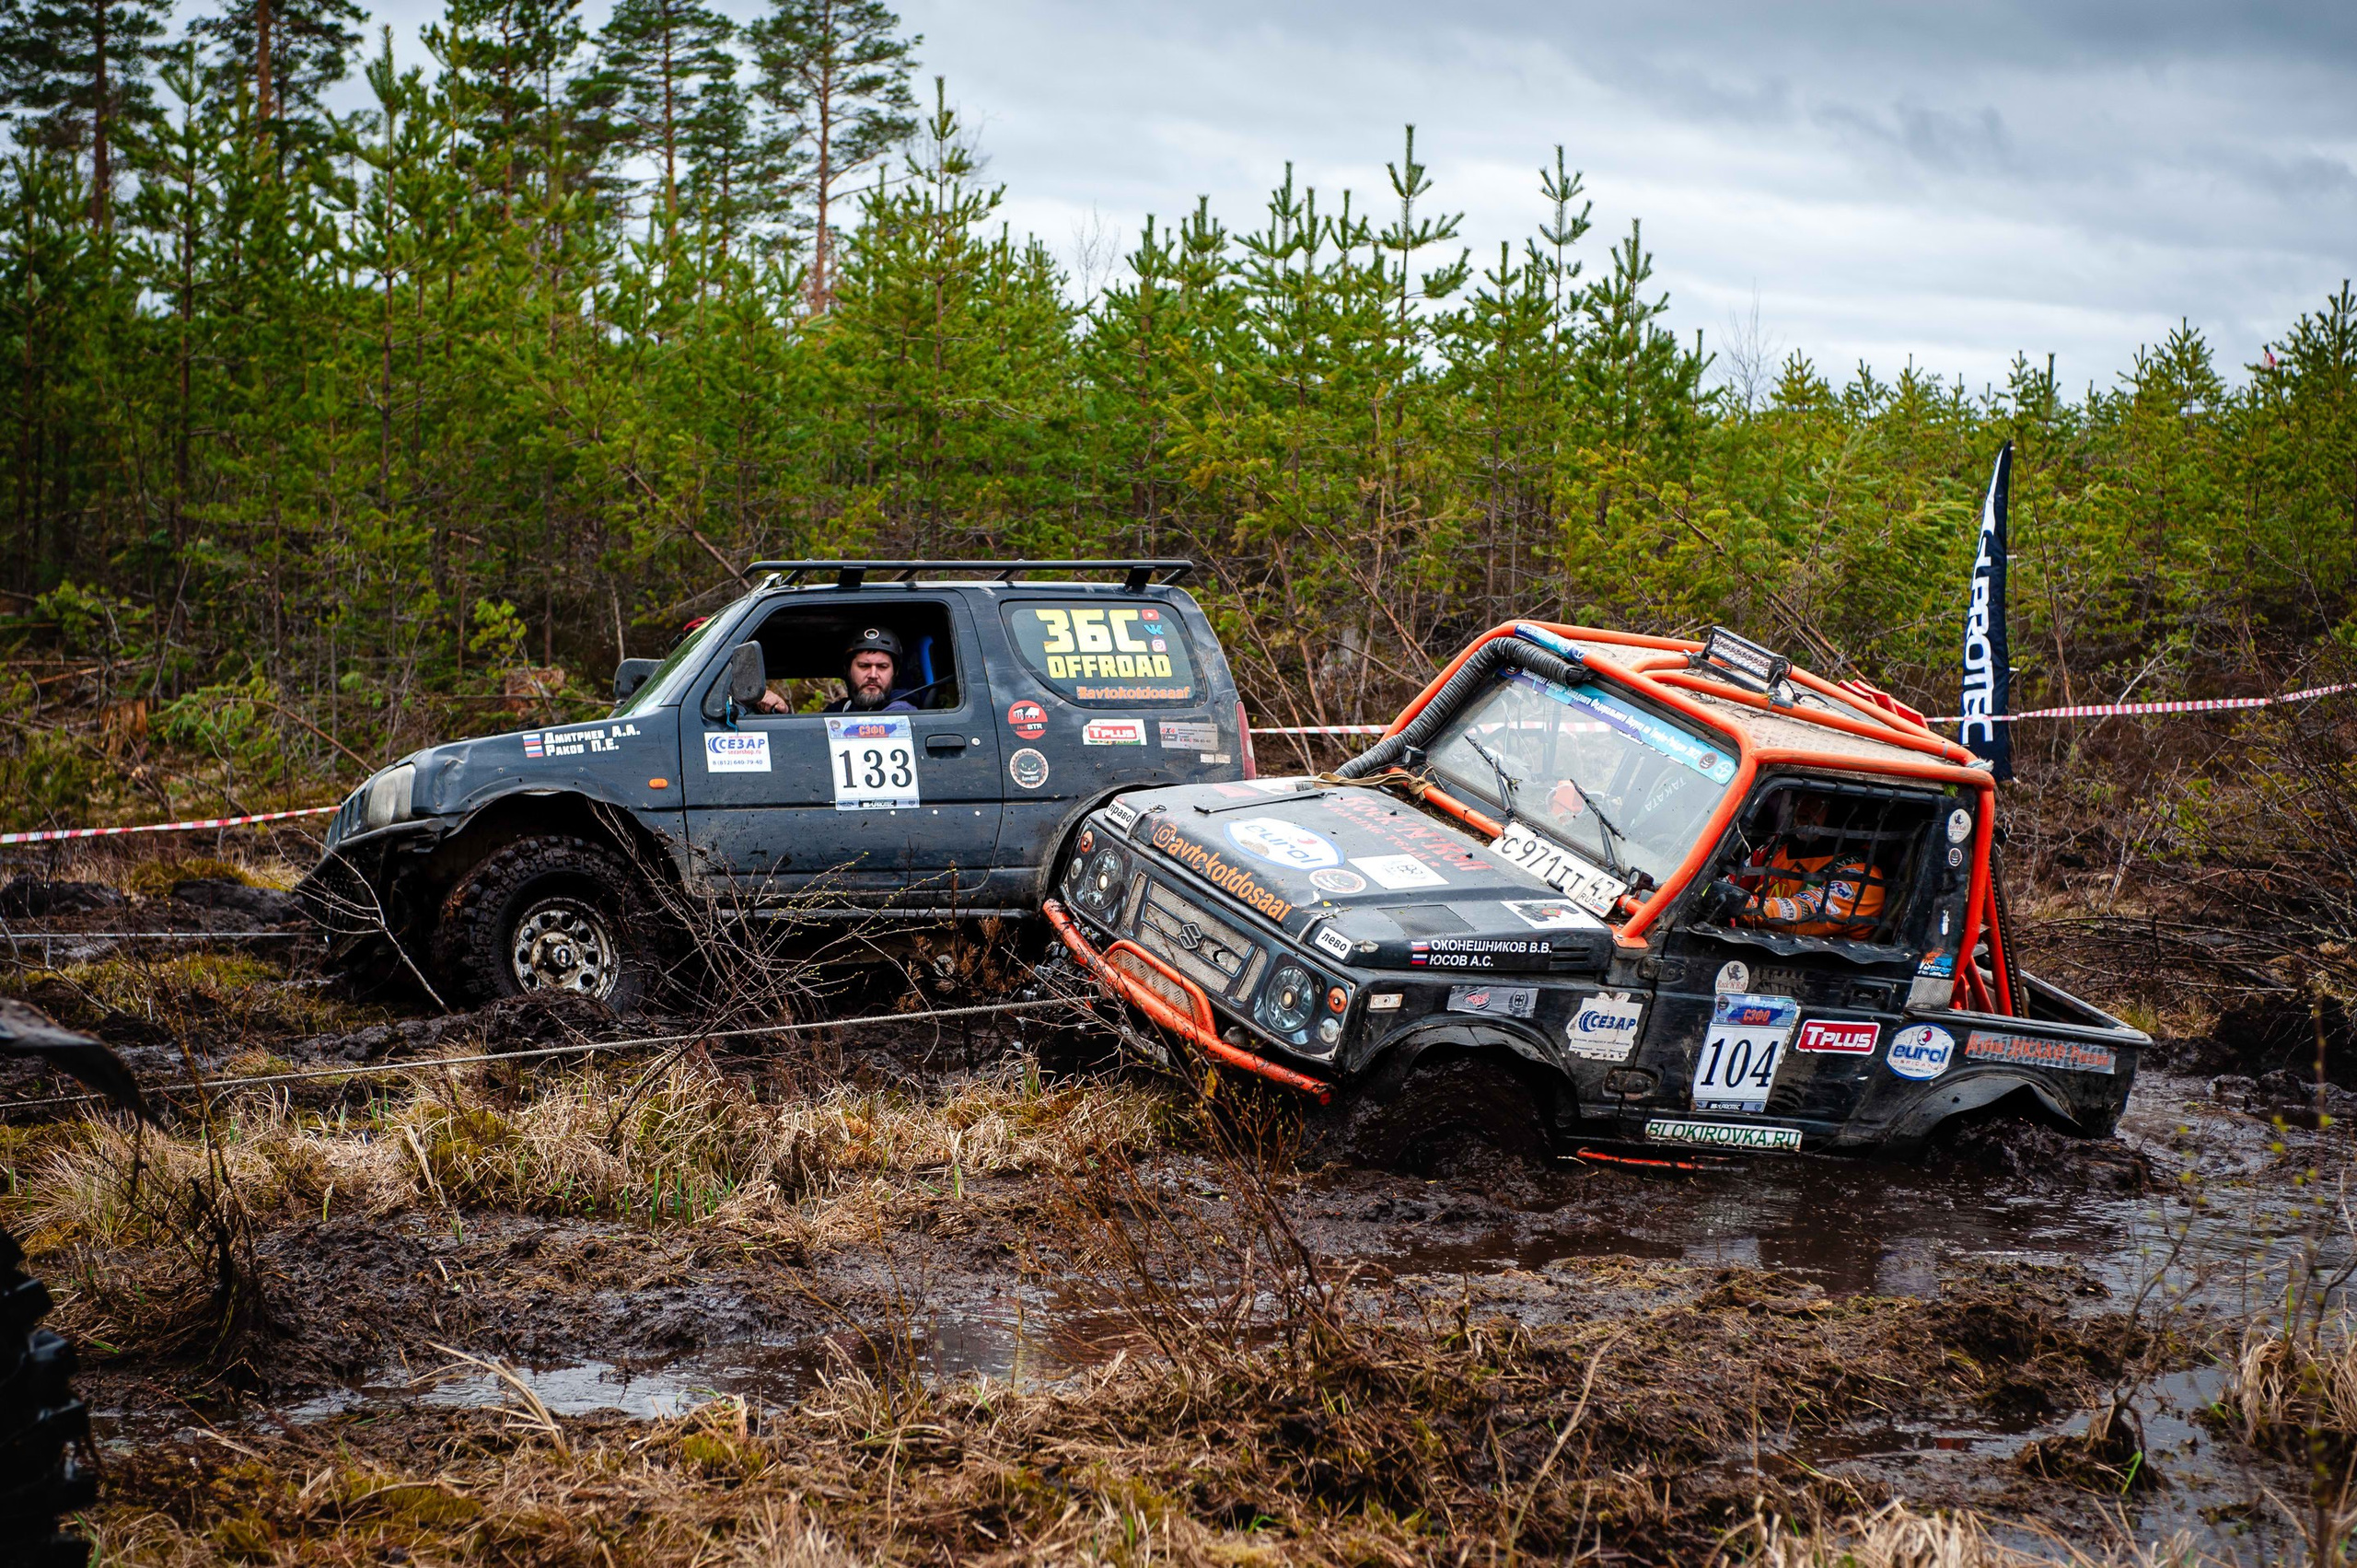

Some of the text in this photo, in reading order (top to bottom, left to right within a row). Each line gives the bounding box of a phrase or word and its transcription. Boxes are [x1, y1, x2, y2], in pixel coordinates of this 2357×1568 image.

[1047, 655, 1173, 679] OFFROAD
[1077, 686, 1190, 699] #avtokotdosaaf
[839, 749, 912, 788] 133
[1108, 804, 1132, 823] право
[1579, 893, 1596, 906] RUS
[1322, 933, 1347, 952] лево
[1431, 939, 1552, 955] ОКОНЕШНИКОВ В.В.
[1429, 954, 1494, 967] ЮСОВ А.С.
[1591, 1015, 1637, 1030] СЕЗАР
[1700, 1038, 1779, 1087] 104
[1893, 1044, 1950, 1063] eurol
[1648, 1121, 1801, 1147] BLOKIROVKA.RU
